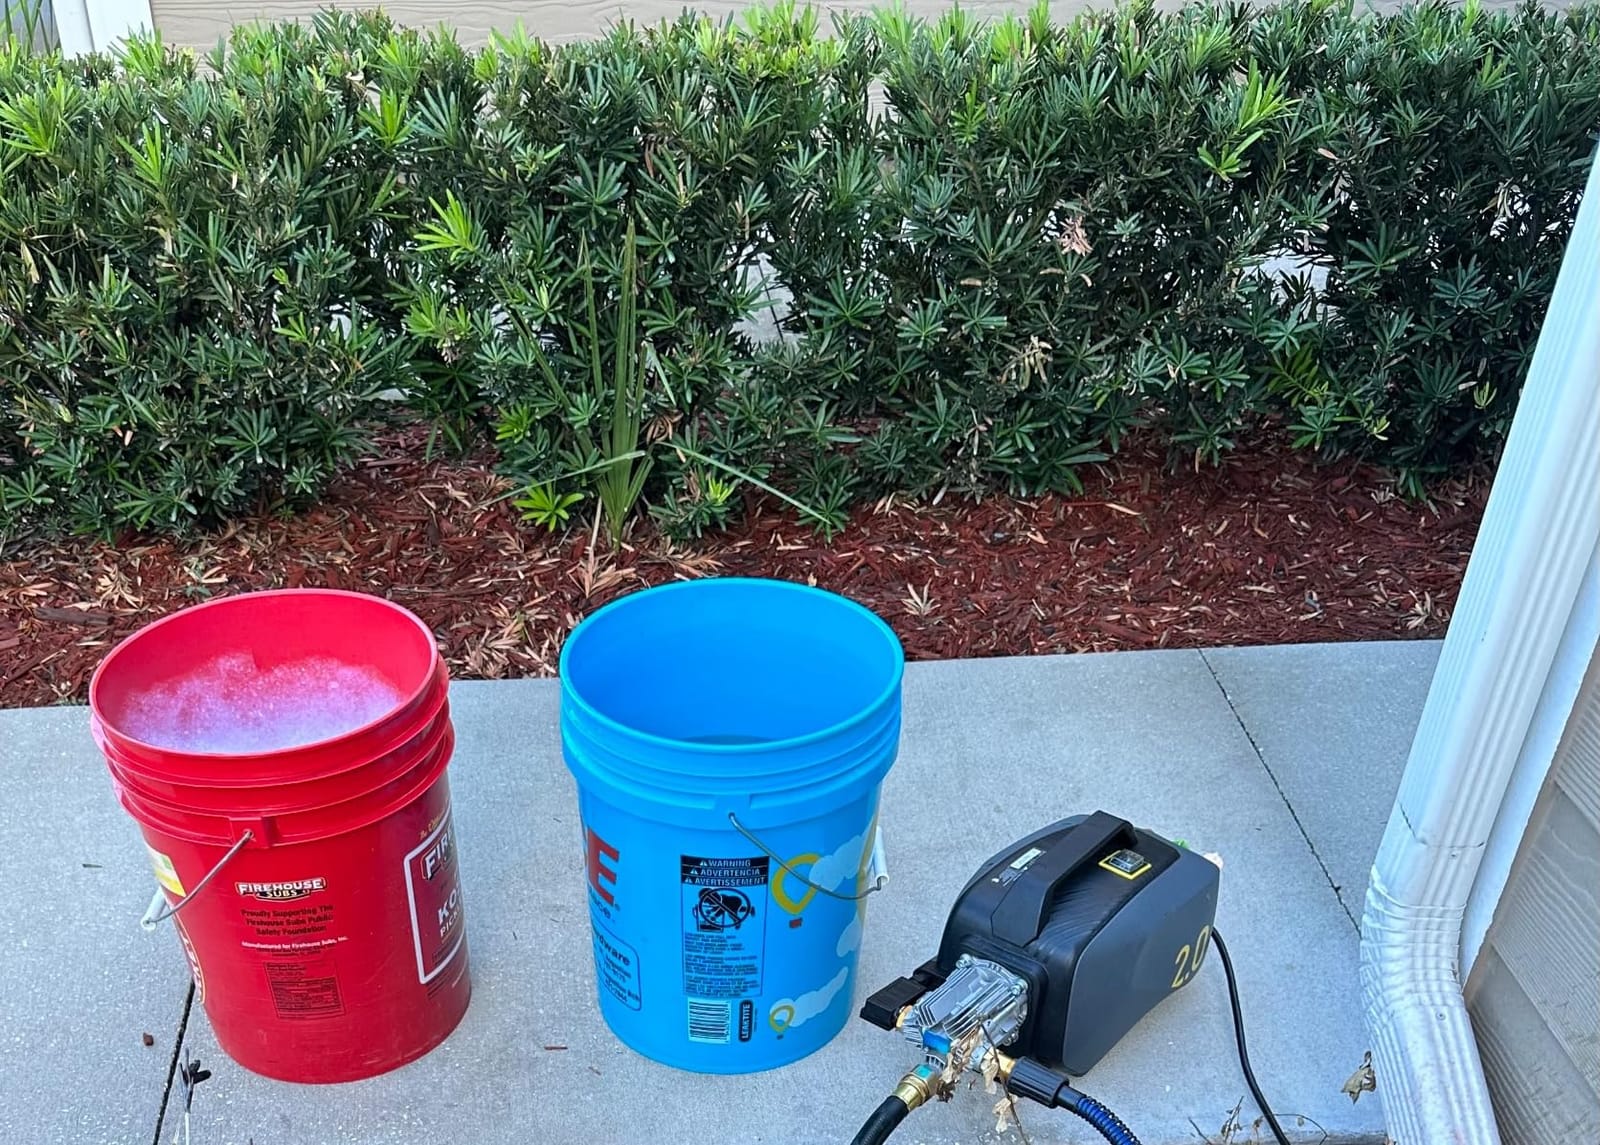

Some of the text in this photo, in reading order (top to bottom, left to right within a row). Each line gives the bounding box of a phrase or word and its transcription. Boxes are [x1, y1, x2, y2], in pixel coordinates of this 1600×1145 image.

[708, 859, 751, 868] WARNING
[700, 868, 760, 877] ADVERTENCIA
[238, 877, 324, 895] FIREHOUSE
[694, 876, 764, 887] AVERTISSEMENT
[265, 888, 299, 898] SUBS
[241, 904, 334, 919] Proudly Supporting The
[246, 913, 333, 927] Firehouse Subs Public
[256, 924, 327, 936] Safety Foundation
[292, 940, 320, 948] Firehouse
[1171, 925, 1210, 988] 2.0
[741, 1003, 751, 1039] LEAKTITE
